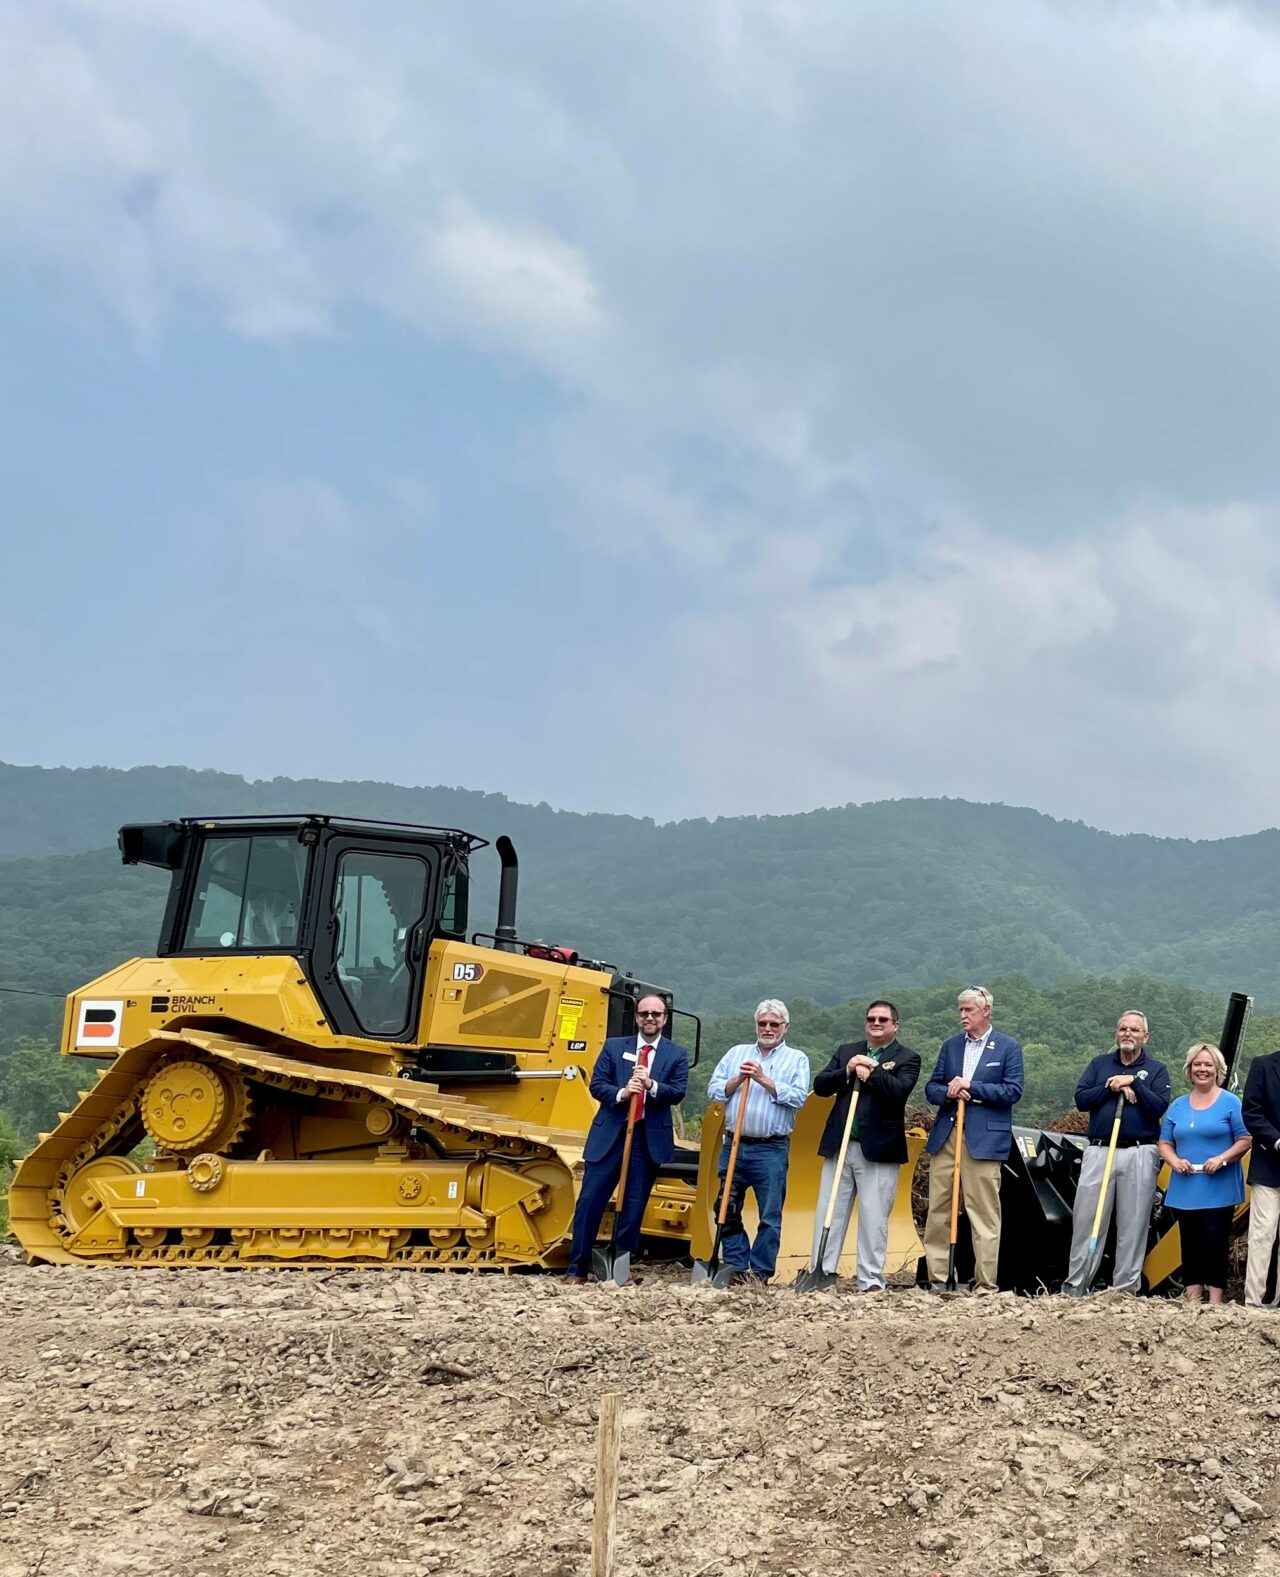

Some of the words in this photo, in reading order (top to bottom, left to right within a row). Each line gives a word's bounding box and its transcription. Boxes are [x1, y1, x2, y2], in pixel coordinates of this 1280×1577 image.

[453, 963, 475, 980] D5
[172, 996, 216, 1005] BRANCH
[171, 1004, 198, 1013] CIVIL
[570, 1041, 585, 1050] LGP
